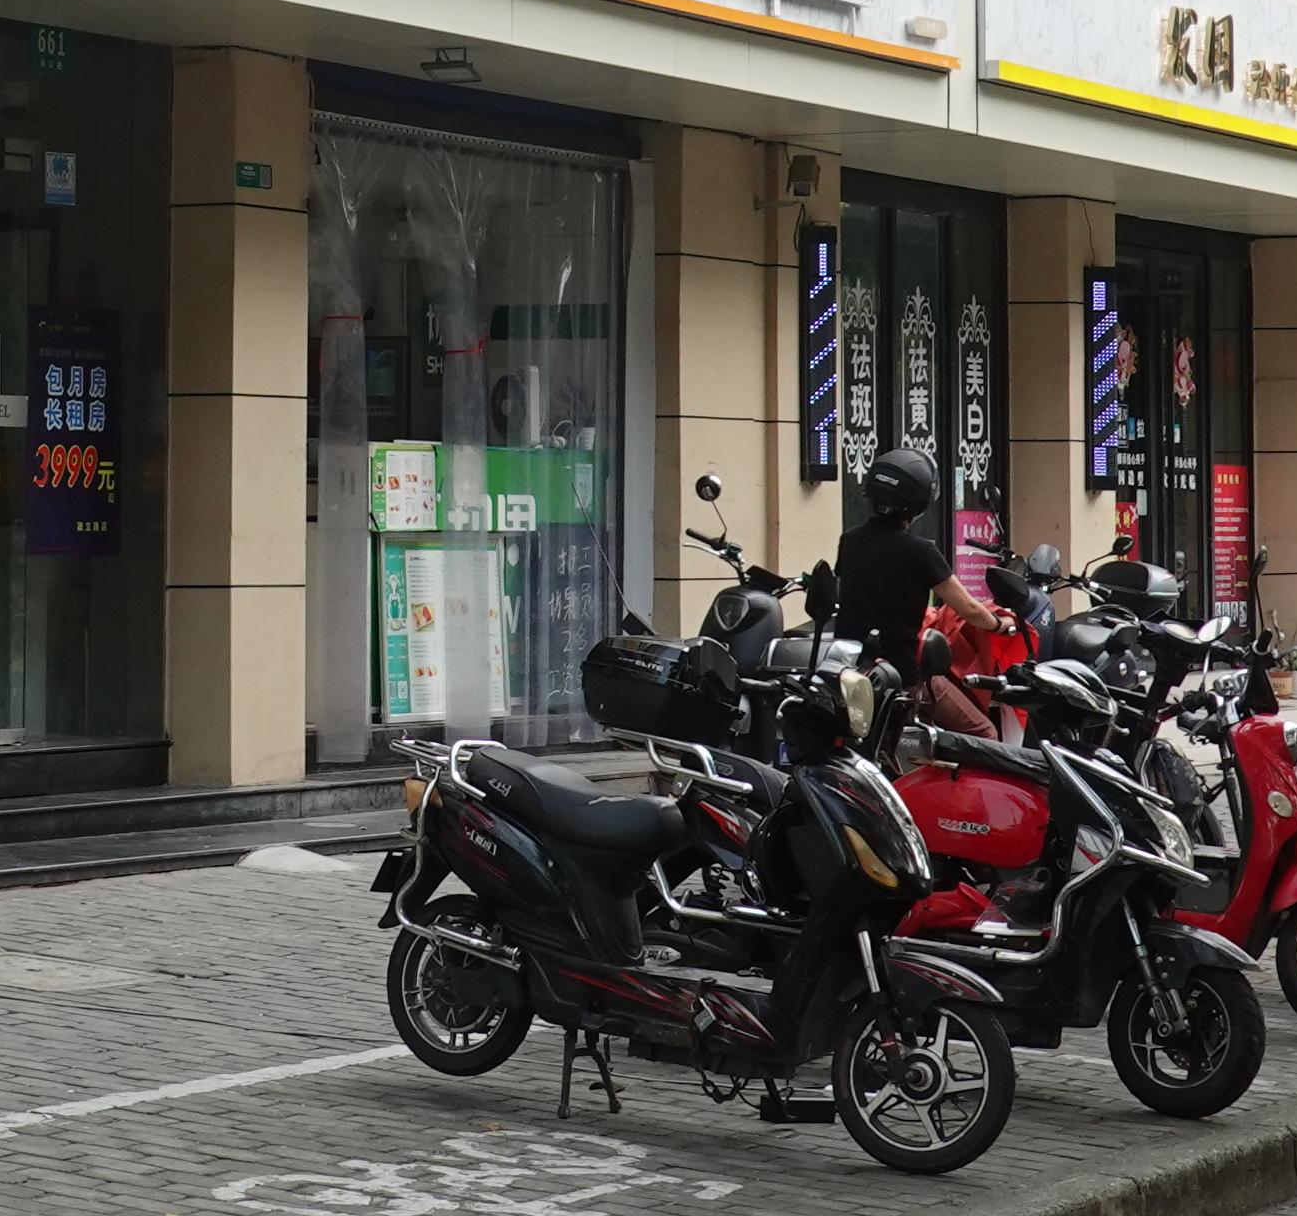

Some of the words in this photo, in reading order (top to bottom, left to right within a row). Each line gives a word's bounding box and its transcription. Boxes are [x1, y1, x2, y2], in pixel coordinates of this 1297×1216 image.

[38, 28, 65, 56] 661
[45, 364, 108, 398] 包月房
[850, 334, 873, 428] 祛斑
[908, 338, 930, 433] 祛黄
[965, 349, 986, 441] 美白
[44, 398, 107, 432] 长租房
